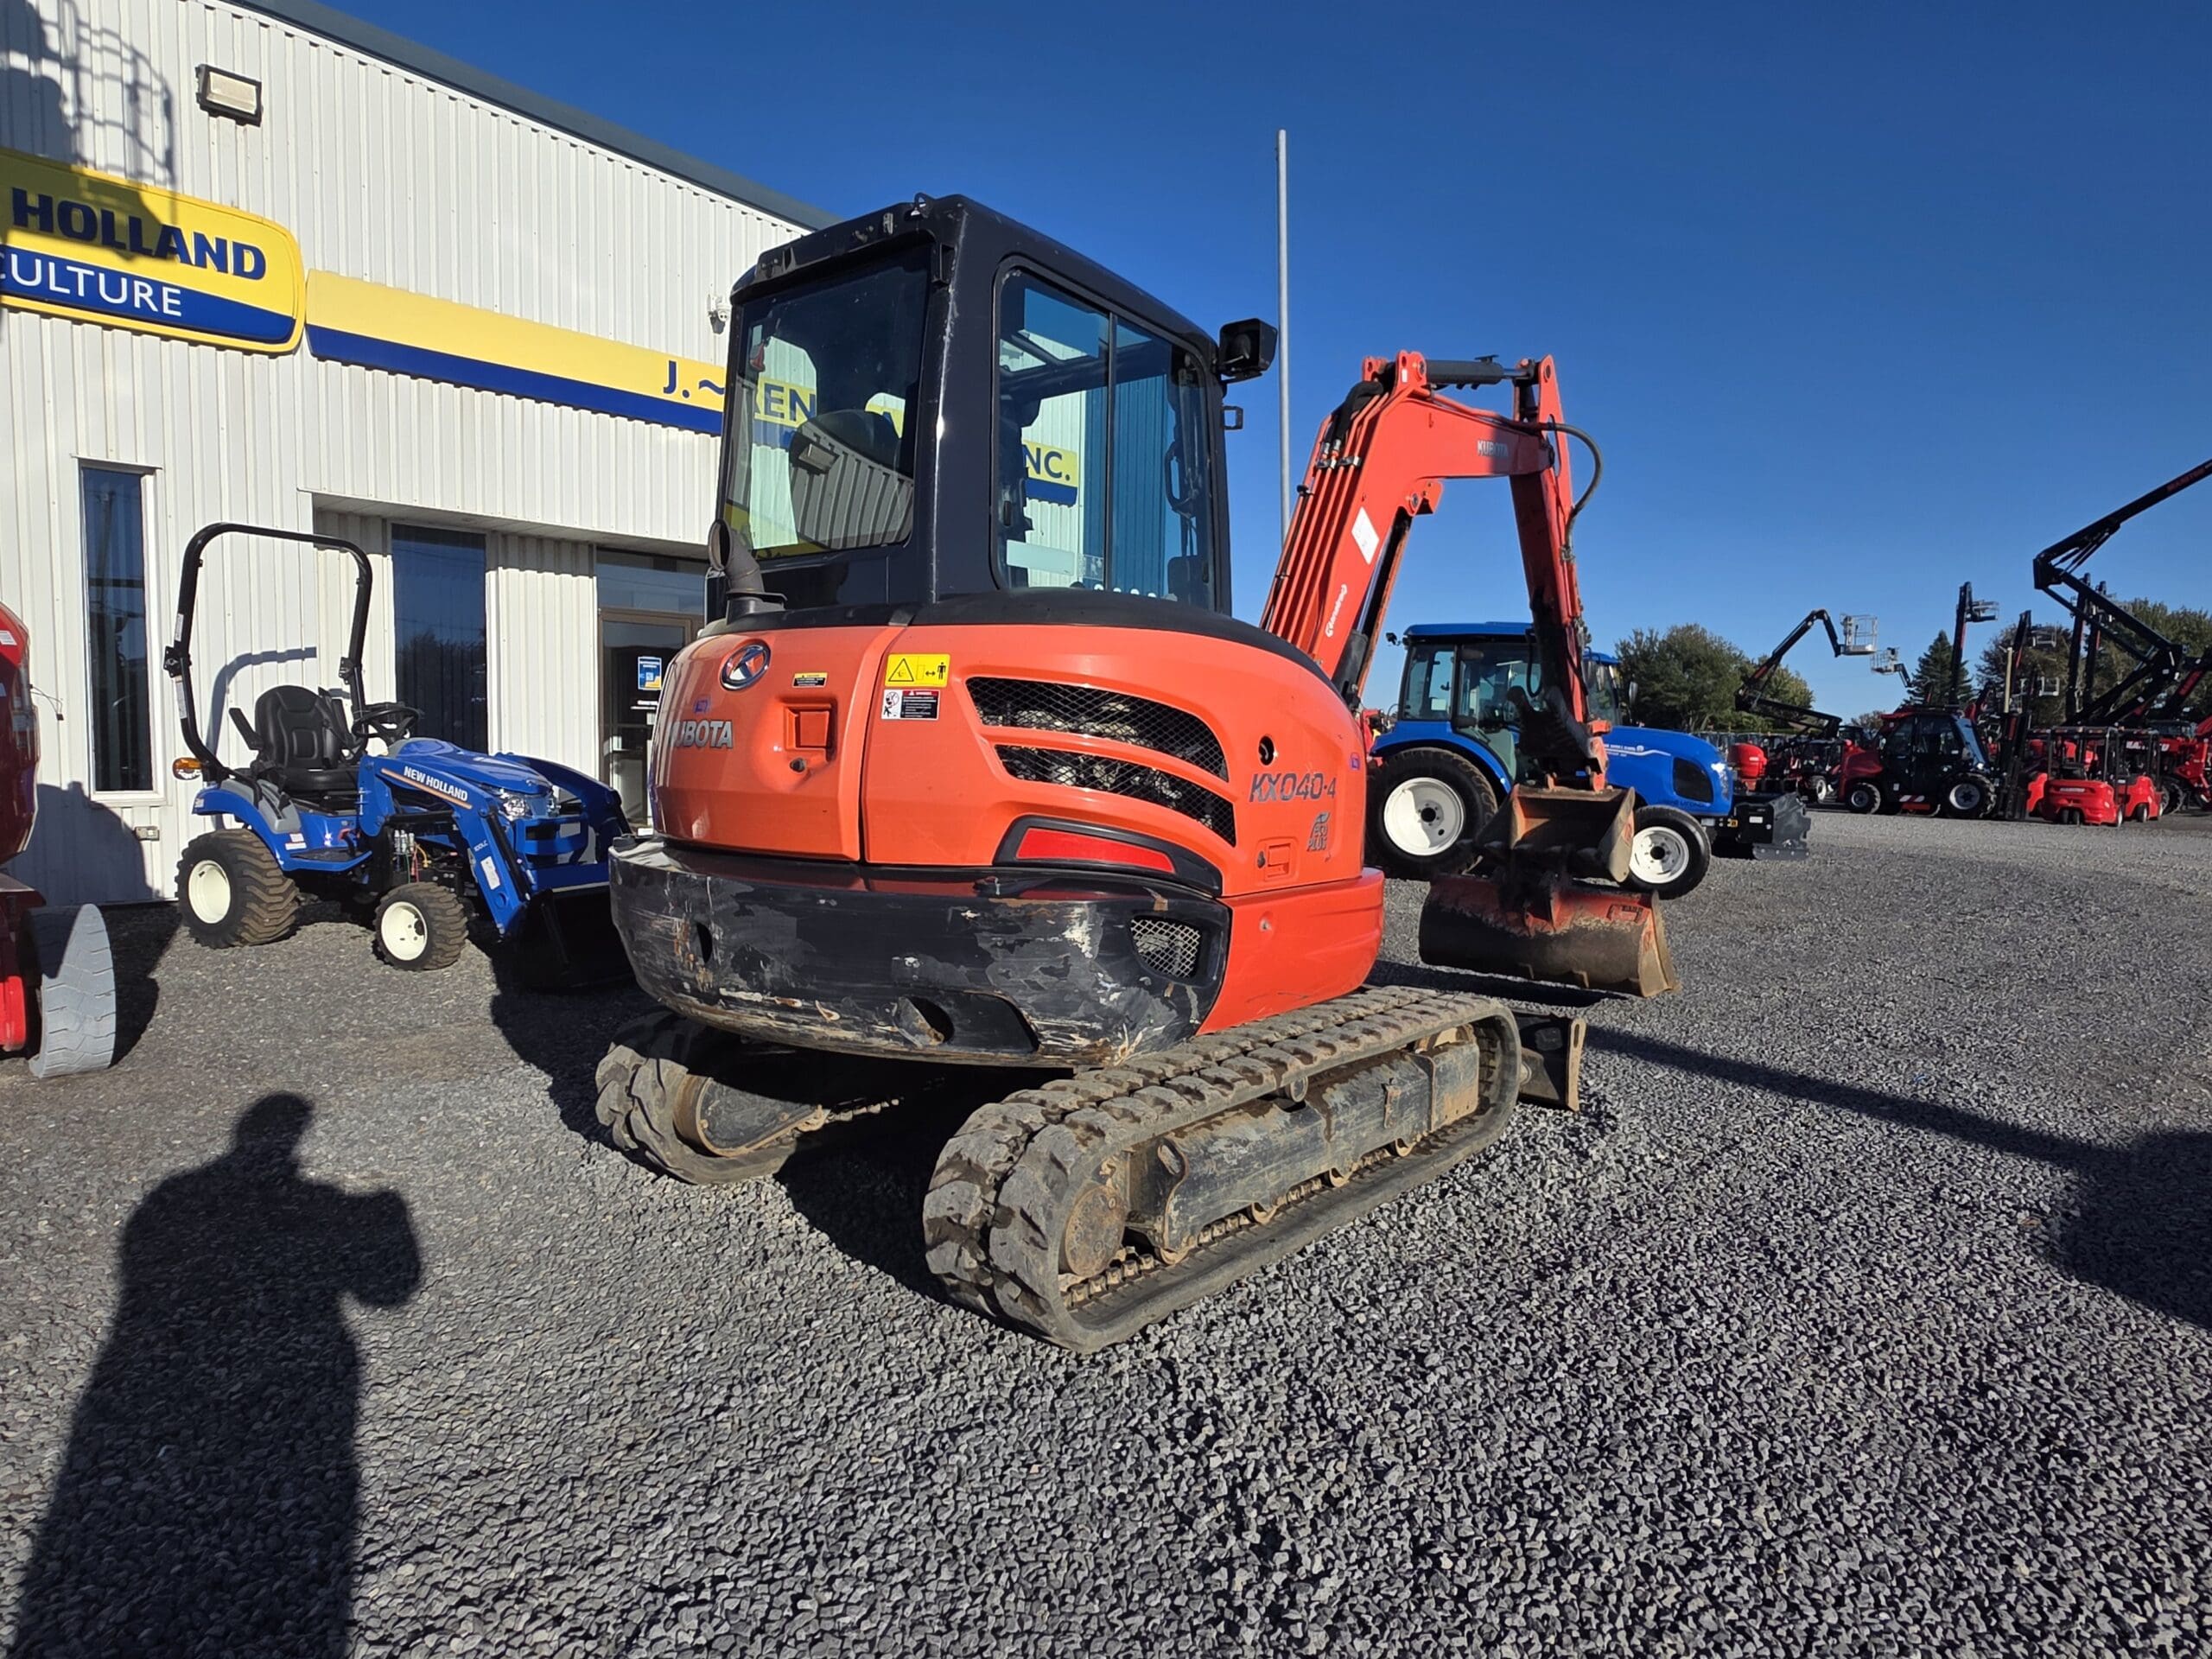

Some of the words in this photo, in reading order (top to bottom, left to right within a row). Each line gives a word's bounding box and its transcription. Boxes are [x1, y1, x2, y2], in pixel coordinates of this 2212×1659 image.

[12, 188, 266, 280] HOLLAND
[1022, 444, 1071, 481] NC.
[669, 719, 733, 748] UBOTA
[404, 766, 426, 783] NEW
[425, 775, 467, 801] HOLLAND
